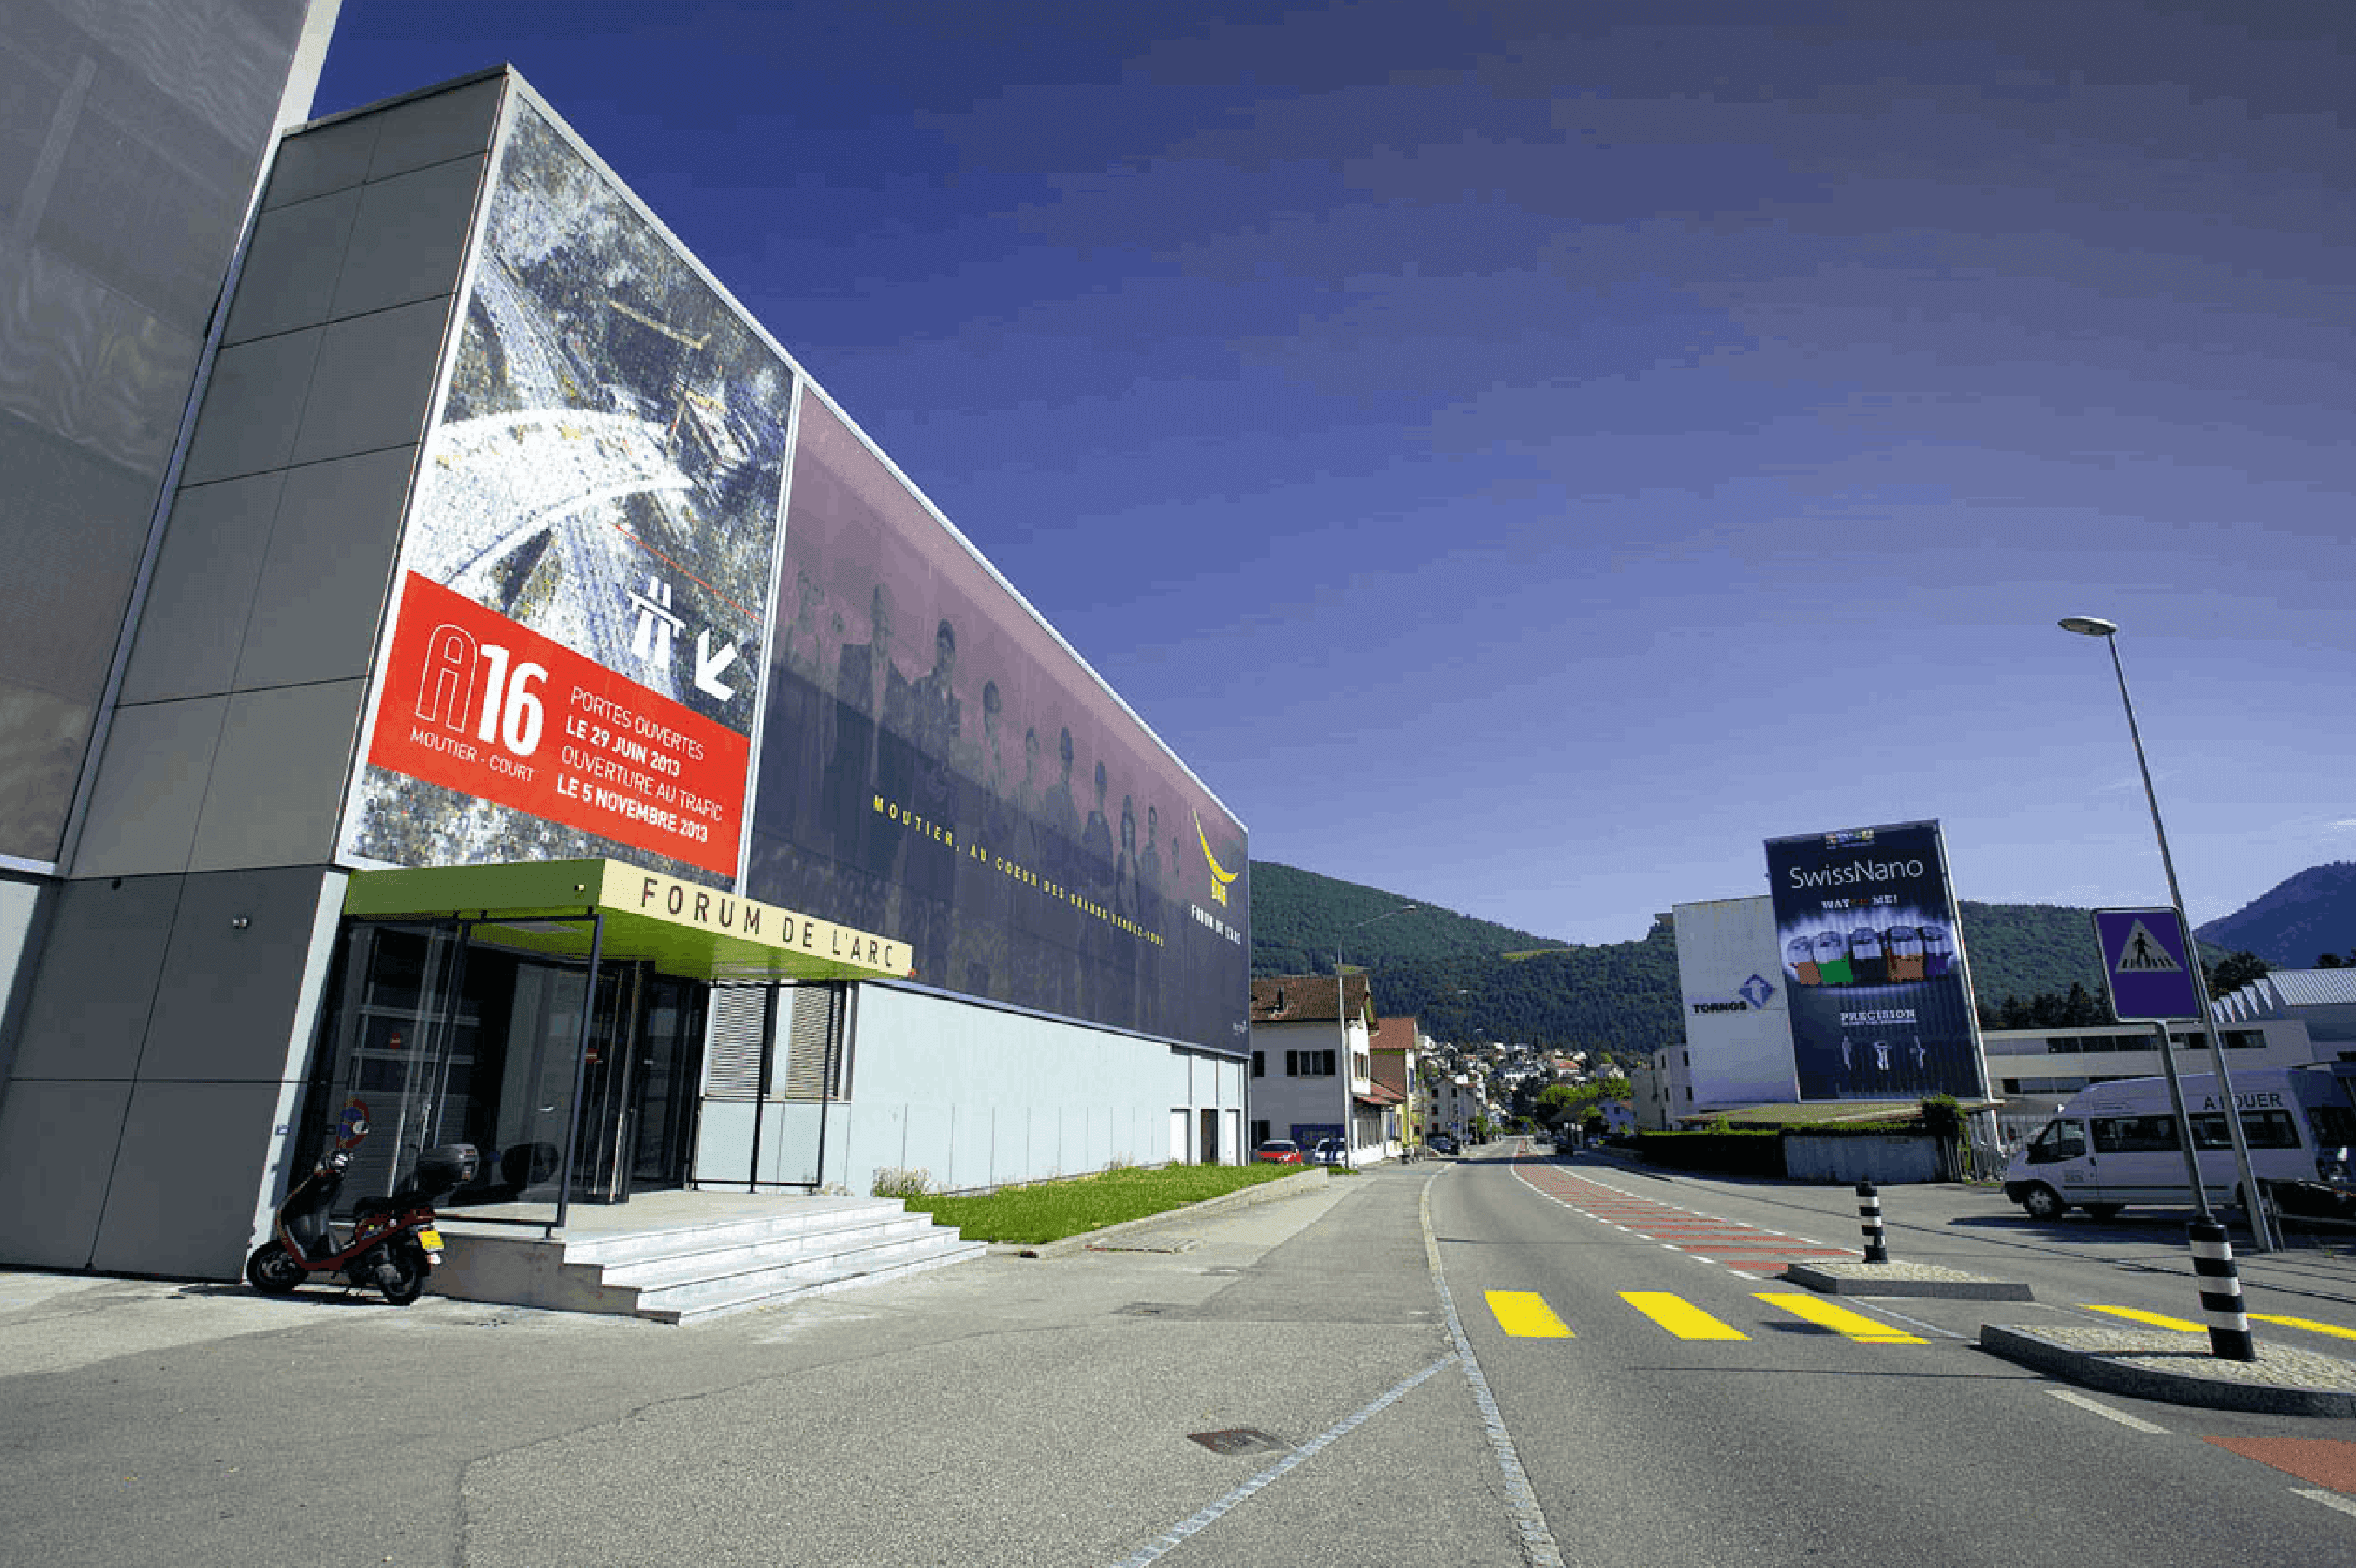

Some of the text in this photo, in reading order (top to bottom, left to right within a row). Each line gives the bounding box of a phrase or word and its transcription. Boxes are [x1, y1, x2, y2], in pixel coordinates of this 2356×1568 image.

[416, 624, 548, 756] A16
[571, 686, 704, 760] PORTES OUVERTES
[410, 725, 477, 762] MOUTIER
[489, 754, 533, 781] COURT
[566, 715, 681, 777] LE 29 JUIN 2013
[558, 774, 707, 843] LE 5 NOVEMBRE 2013
[561, 746, 722, 821] OUVERTURE AU TRAFIC
[873, 795, 960, 852] MOUTIER,
[970, 844, 987, 864] AU
[1790, 859, 1924, 889] SwissNano
[641, 877, 893, 968] FORUM DE L'ARC
